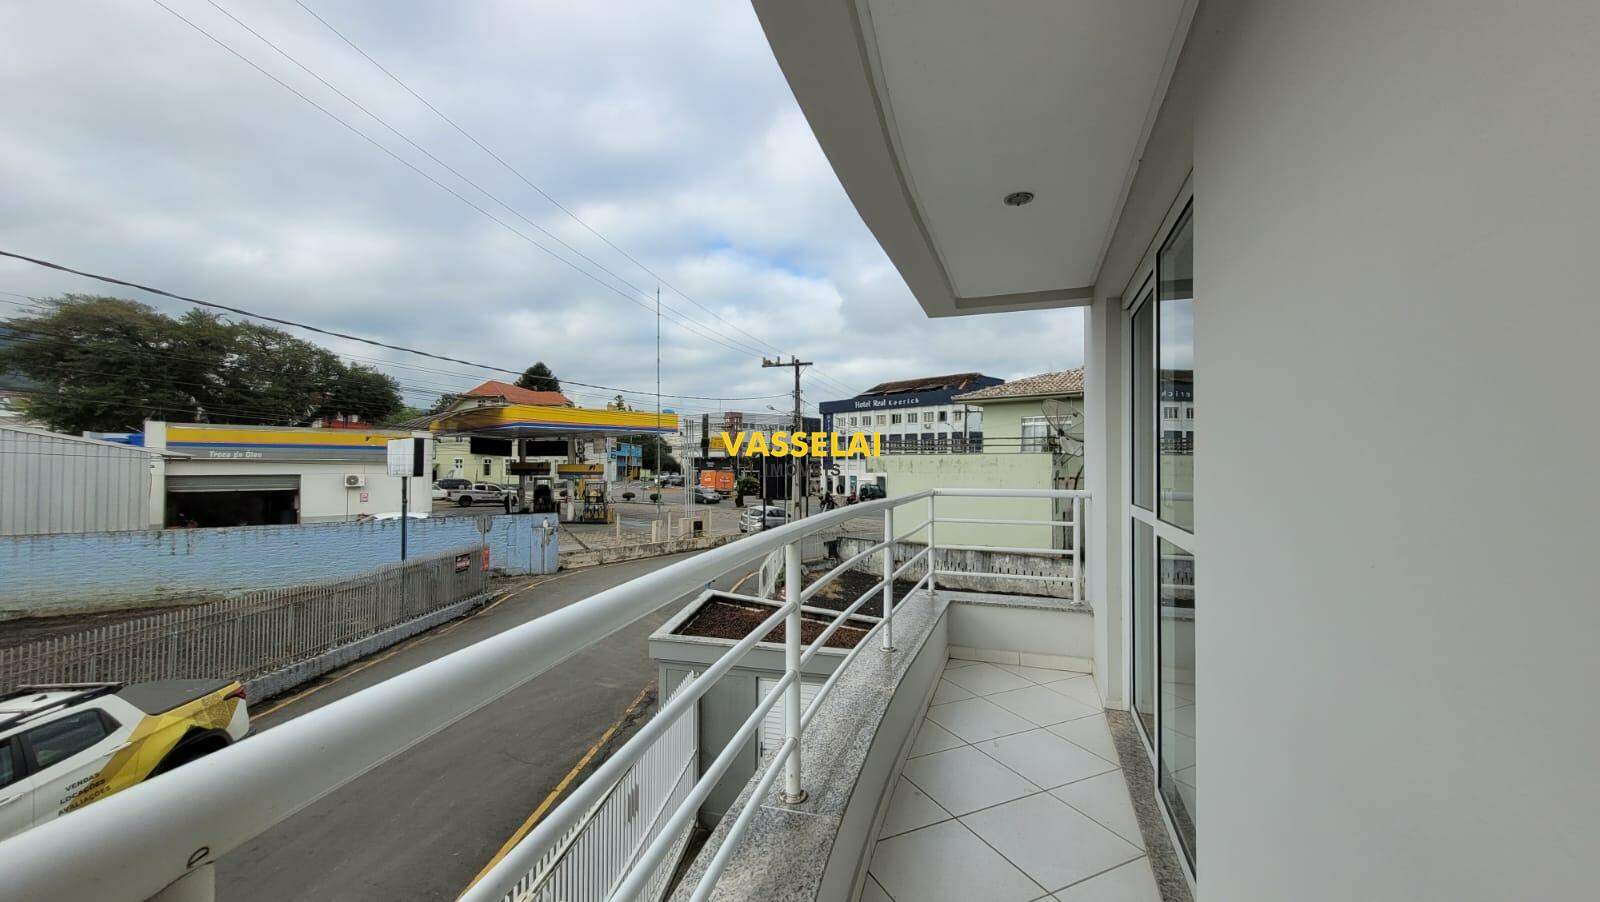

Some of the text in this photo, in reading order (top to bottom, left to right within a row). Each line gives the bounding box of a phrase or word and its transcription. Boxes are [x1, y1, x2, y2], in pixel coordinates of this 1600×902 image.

[854, 401, 870, 409] Hotel
[872, 399, 886, 407] Real
[209, 450, 231, 458] Troca
[233, 450, 243, 458] de
[64, 772, 101, 792] VENDAS
